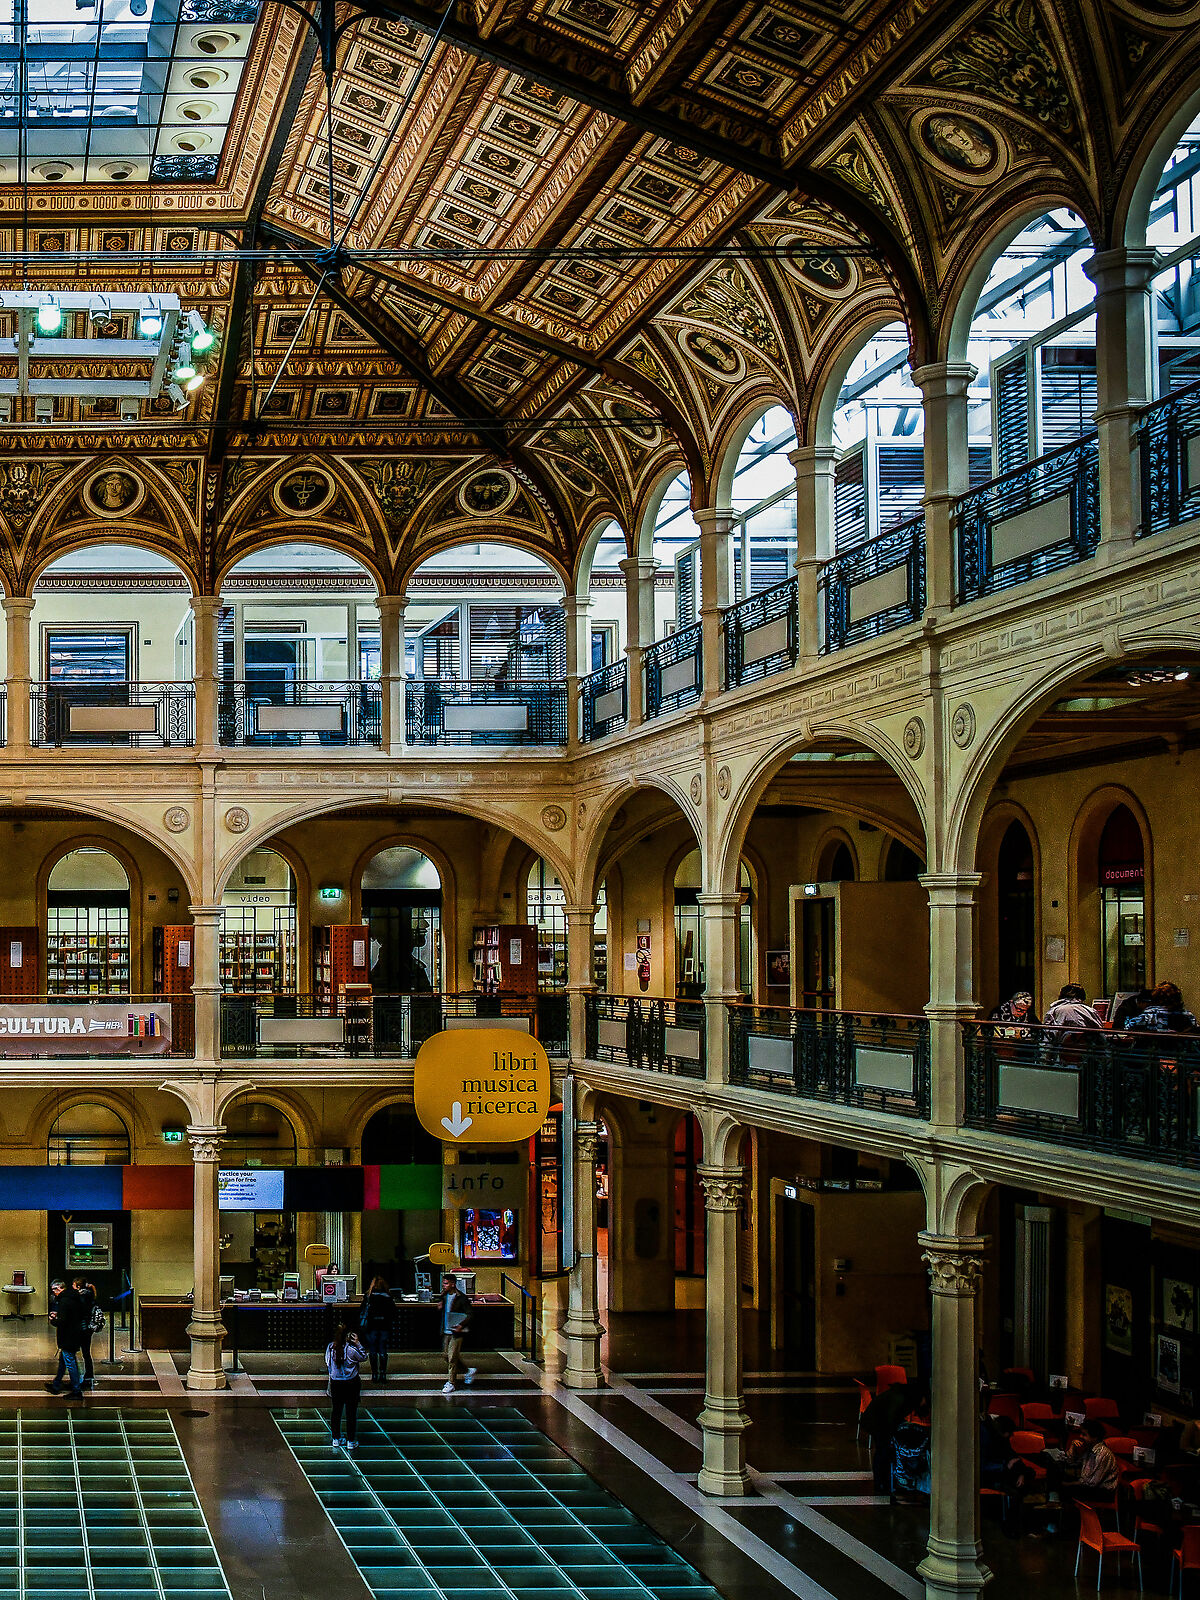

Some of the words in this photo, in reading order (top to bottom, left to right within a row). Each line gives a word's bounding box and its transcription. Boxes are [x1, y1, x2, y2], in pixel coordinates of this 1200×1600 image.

[240, 894, 271, 903] video
[493, 1051, 539, 1071] libri
[461, 1074, 539, 1095] musica
[467, 1096, 539, 1115] ricerca
[447, 1172, 505, 1190] info
